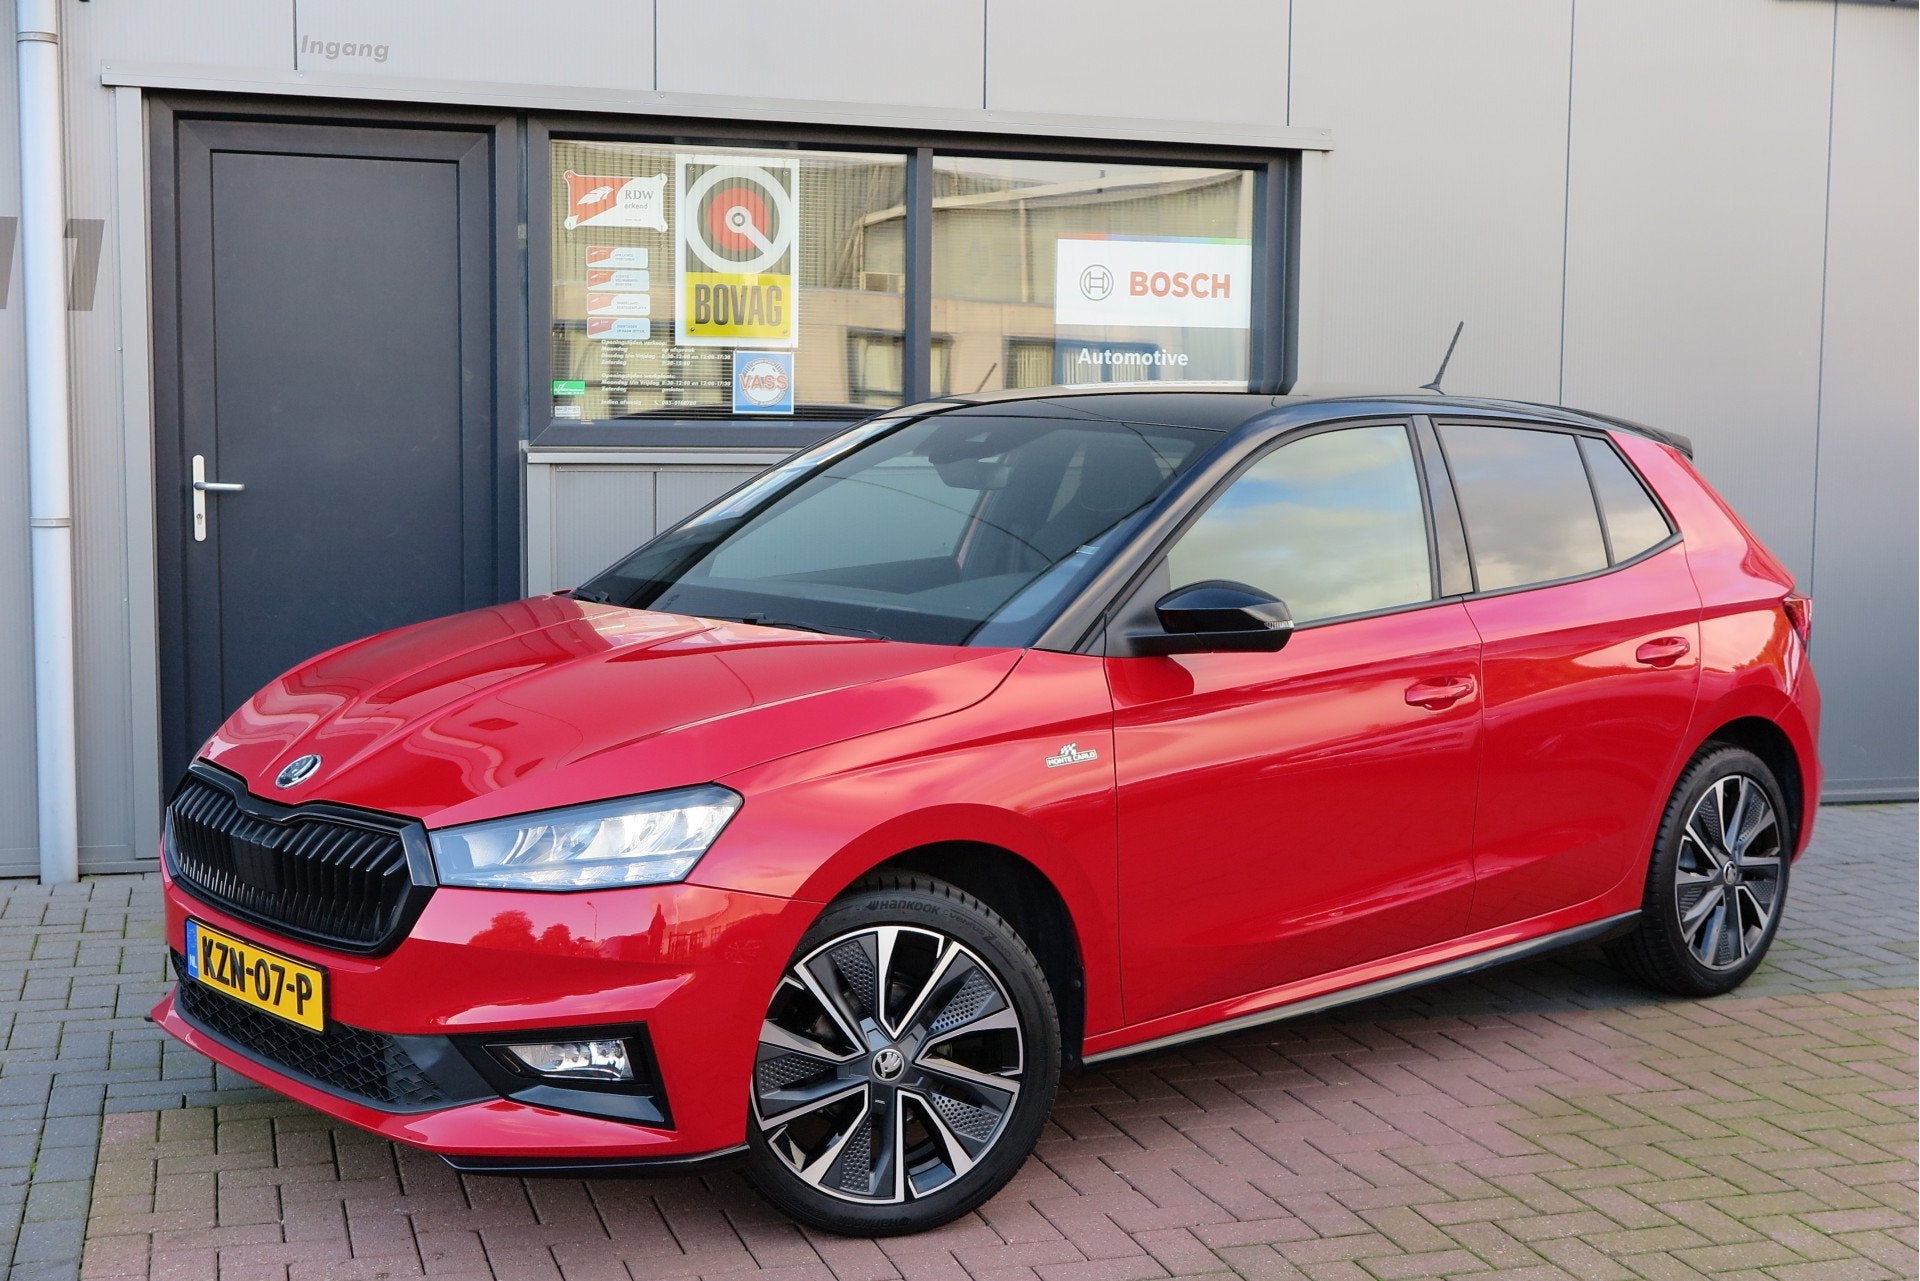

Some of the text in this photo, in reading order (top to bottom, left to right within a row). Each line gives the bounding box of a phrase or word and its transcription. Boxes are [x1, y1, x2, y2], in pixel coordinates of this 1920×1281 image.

[300, 35, 389, 63] Ingang
[624, 190, 654, 200] RDW
[1129, 271, 1231, 299] BOSCH
[694, 283, 783, 327] BOVAG
[1078, 347, 1189, 367] Automotive
[740, 374, 788, 391] VASS
[1048, 752, 1095, 766] MONTE CARLO
[189, 954, 198, 969] NL
[202, 935, 313, 1016] KZN-07-P
